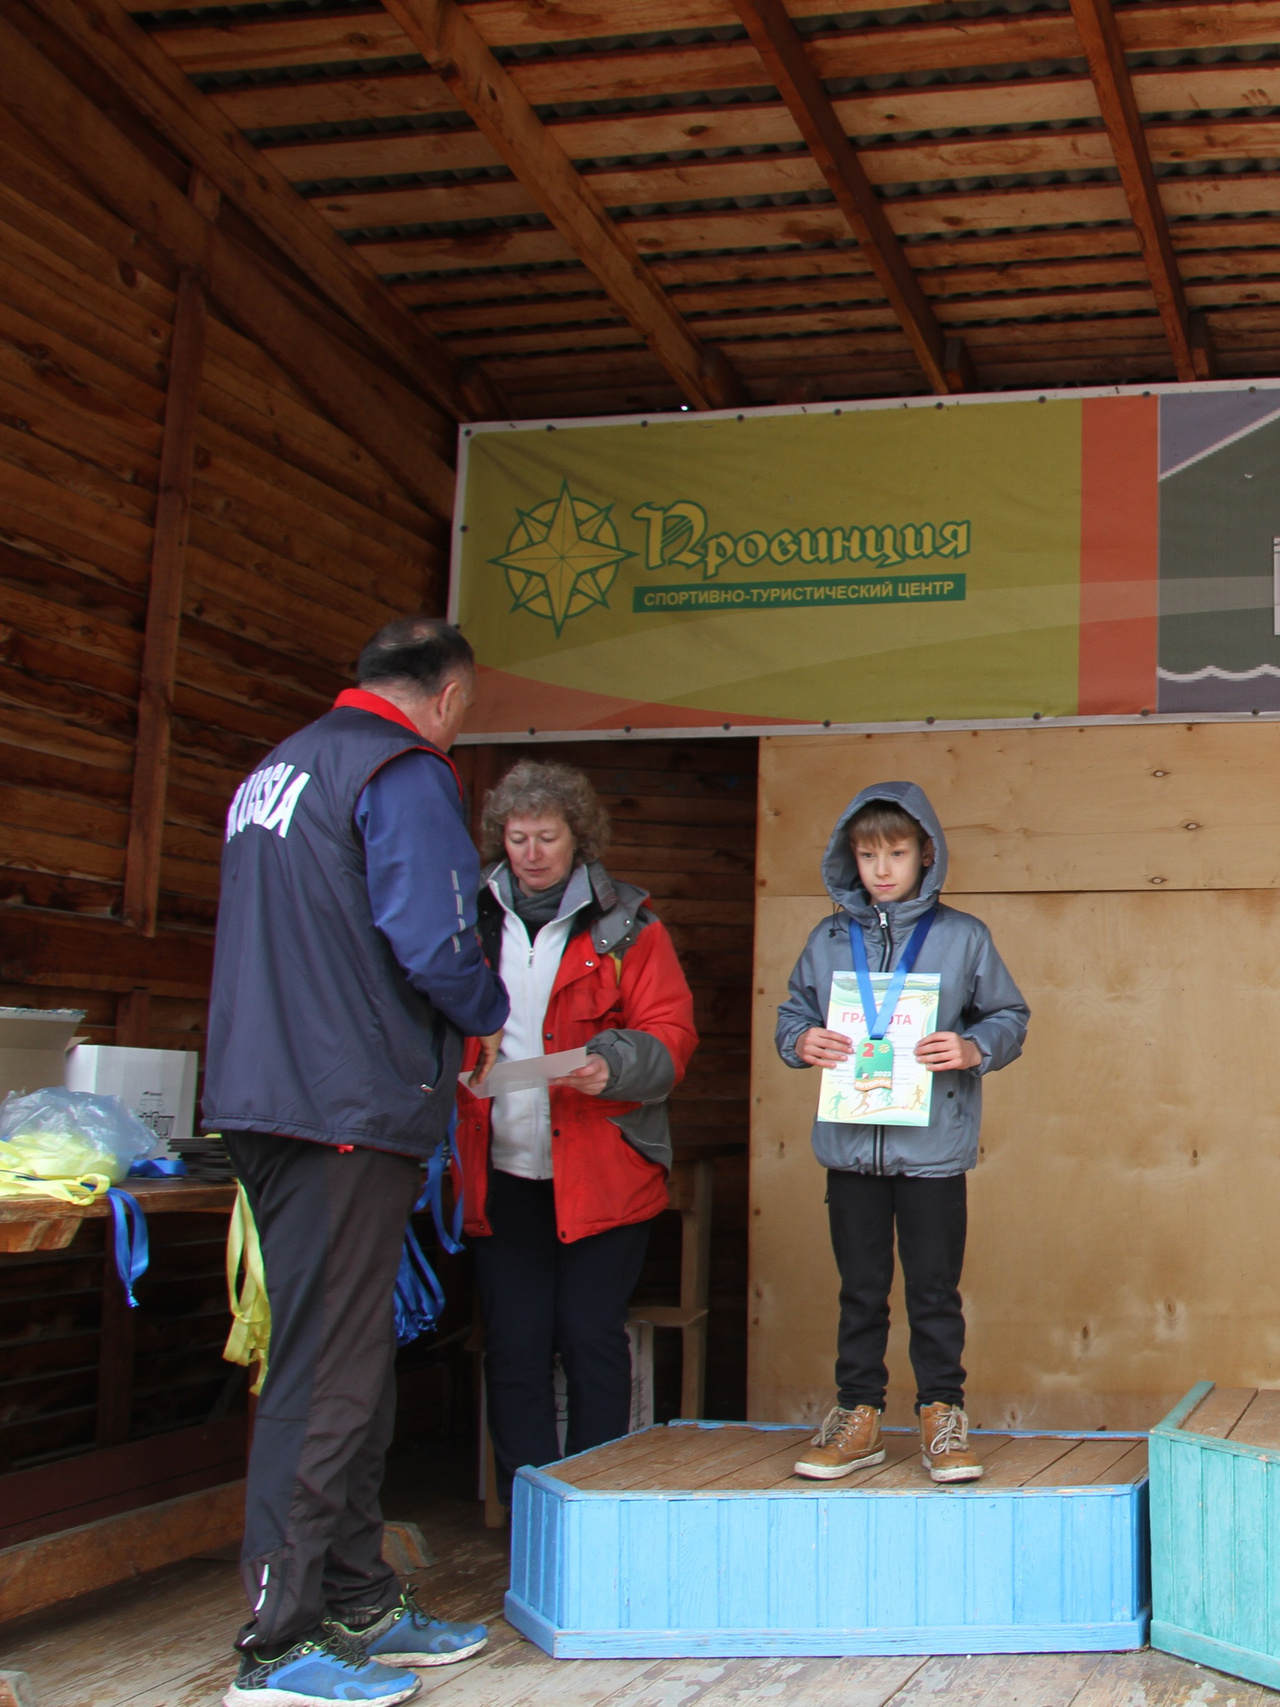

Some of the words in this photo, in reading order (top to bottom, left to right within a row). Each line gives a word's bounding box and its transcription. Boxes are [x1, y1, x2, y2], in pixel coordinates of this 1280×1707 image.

[631, 499, 972, 581] Провинция
[643, 580, 894, 607] СПОРТИВНО-ТУРИСТИЧЕСКИЙ
[897, 580, 956, 598] ЦЕНТР
[862, 1043, 875, 1058] 2
